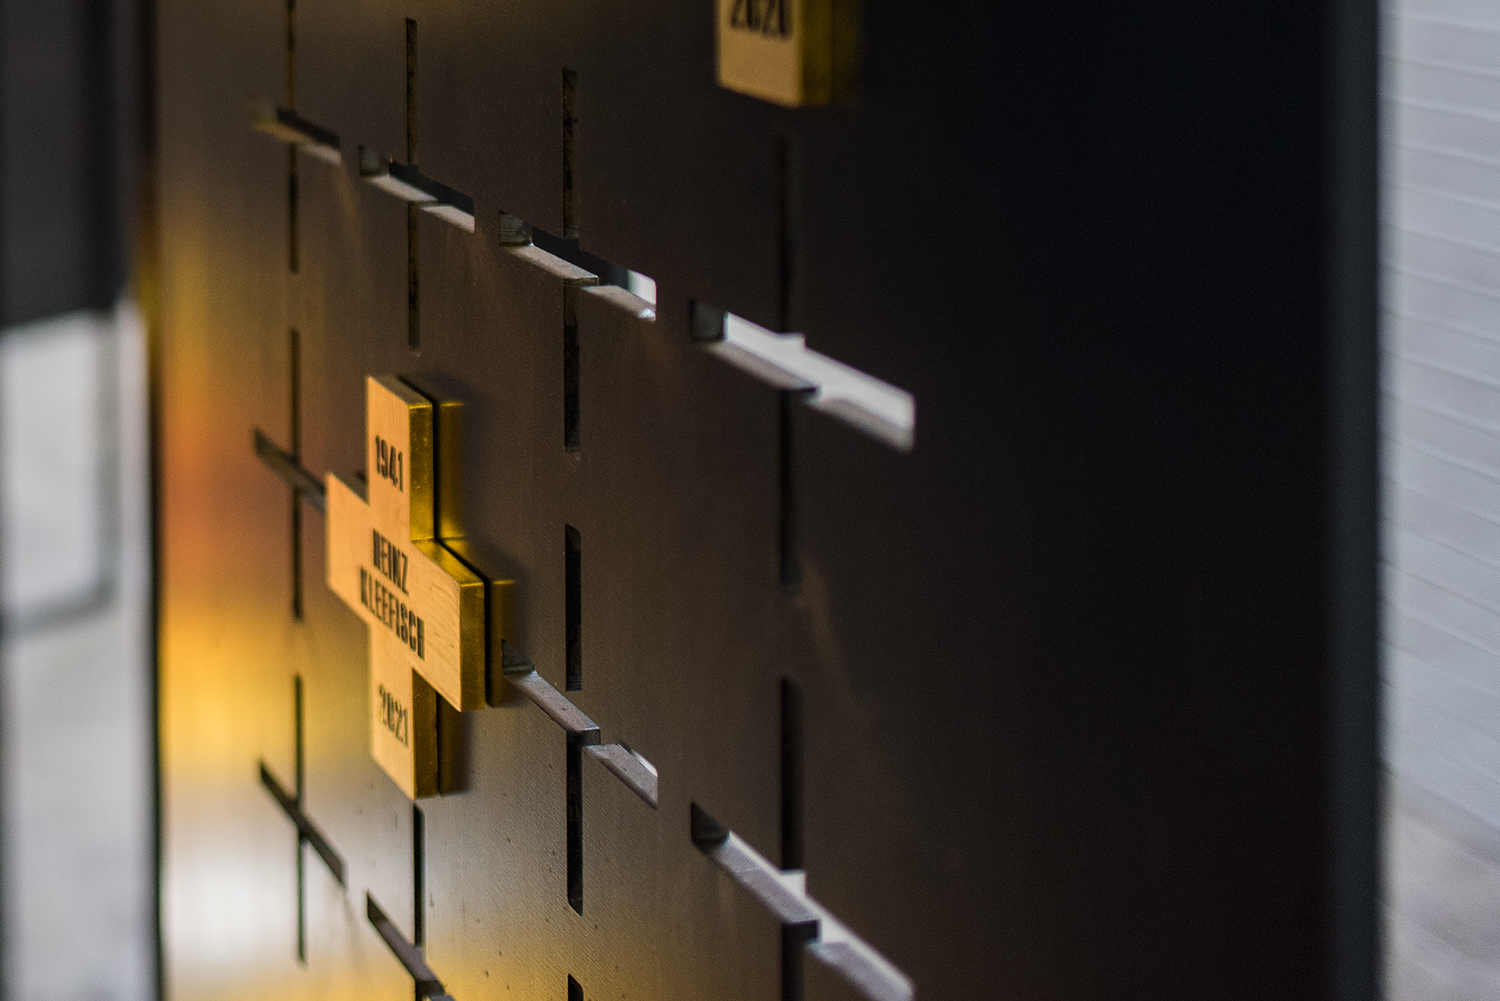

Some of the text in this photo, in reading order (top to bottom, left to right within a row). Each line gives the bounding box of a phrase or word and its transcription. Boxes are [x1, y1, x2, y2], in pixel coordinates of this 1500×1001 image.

[375, 434, 404, 493] 1941
[372, 528, 410, 597] HEINZ
[360, 565, 426, 662] KLEEFISCH
[378, 683, 409, 748] 2021
